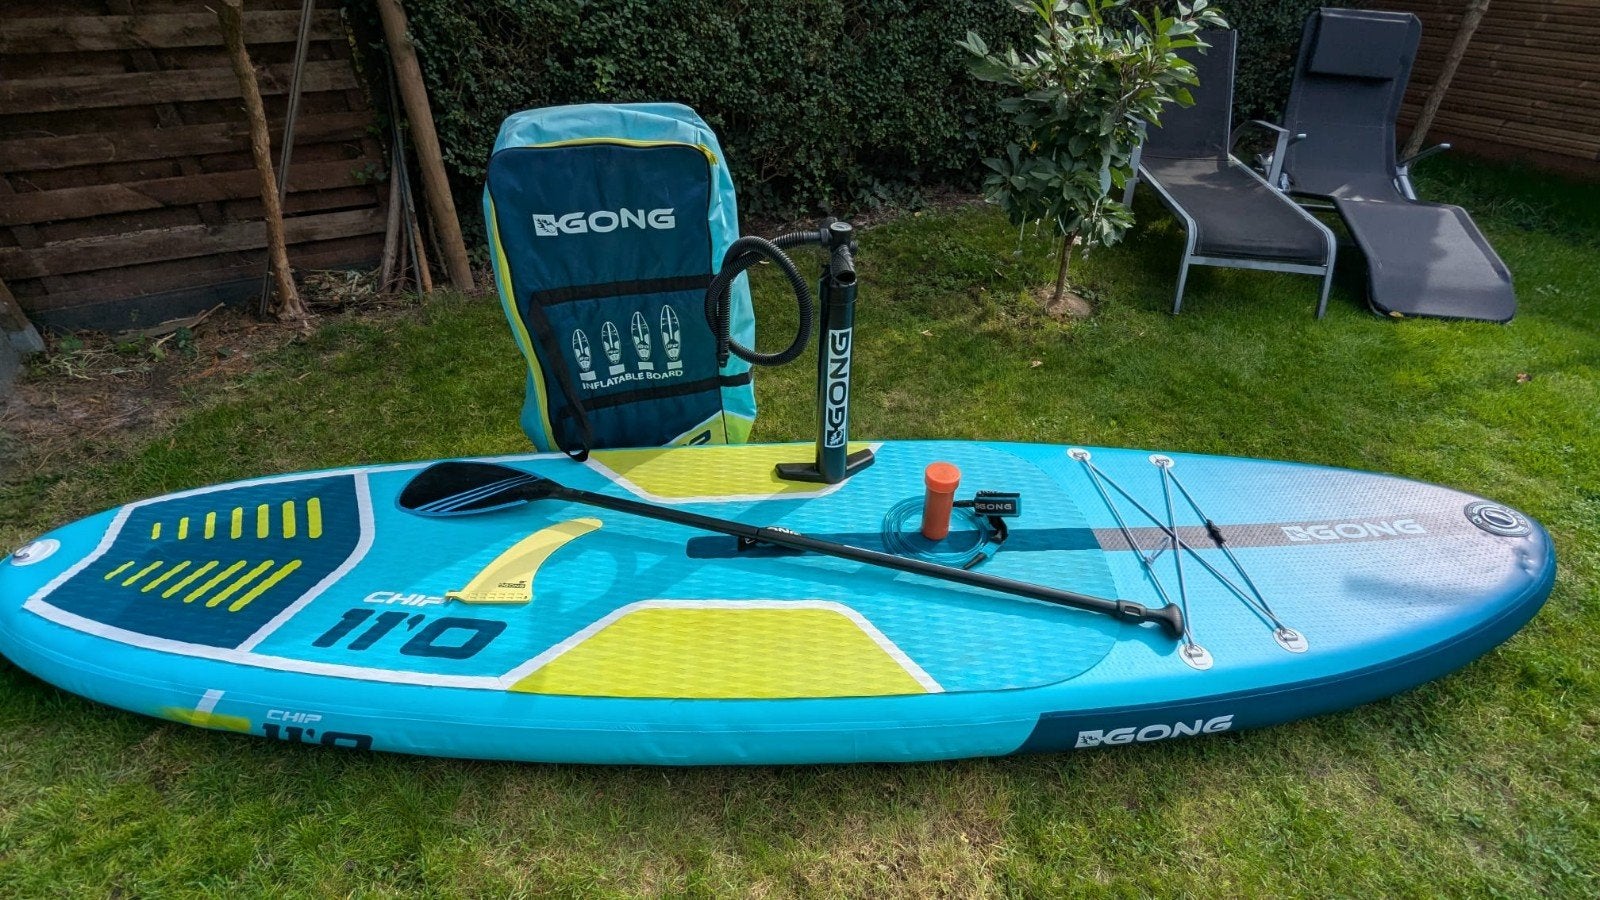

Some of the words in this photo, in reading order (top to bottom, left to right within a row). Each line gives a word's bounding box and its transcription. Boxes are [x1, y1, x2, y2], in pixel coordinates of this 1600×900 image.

[557, 207, 676, 234] GONG
[582, 372, 645, 390] INFLATABLE
[646, 370, 684, 380] BOARD
[827, 330, 851, 429] GONG
[1306, 518, 1428, 541] GONG
[266, 709, 323, 723] CHIP
[1104, 714, 1235, 745] GONG
